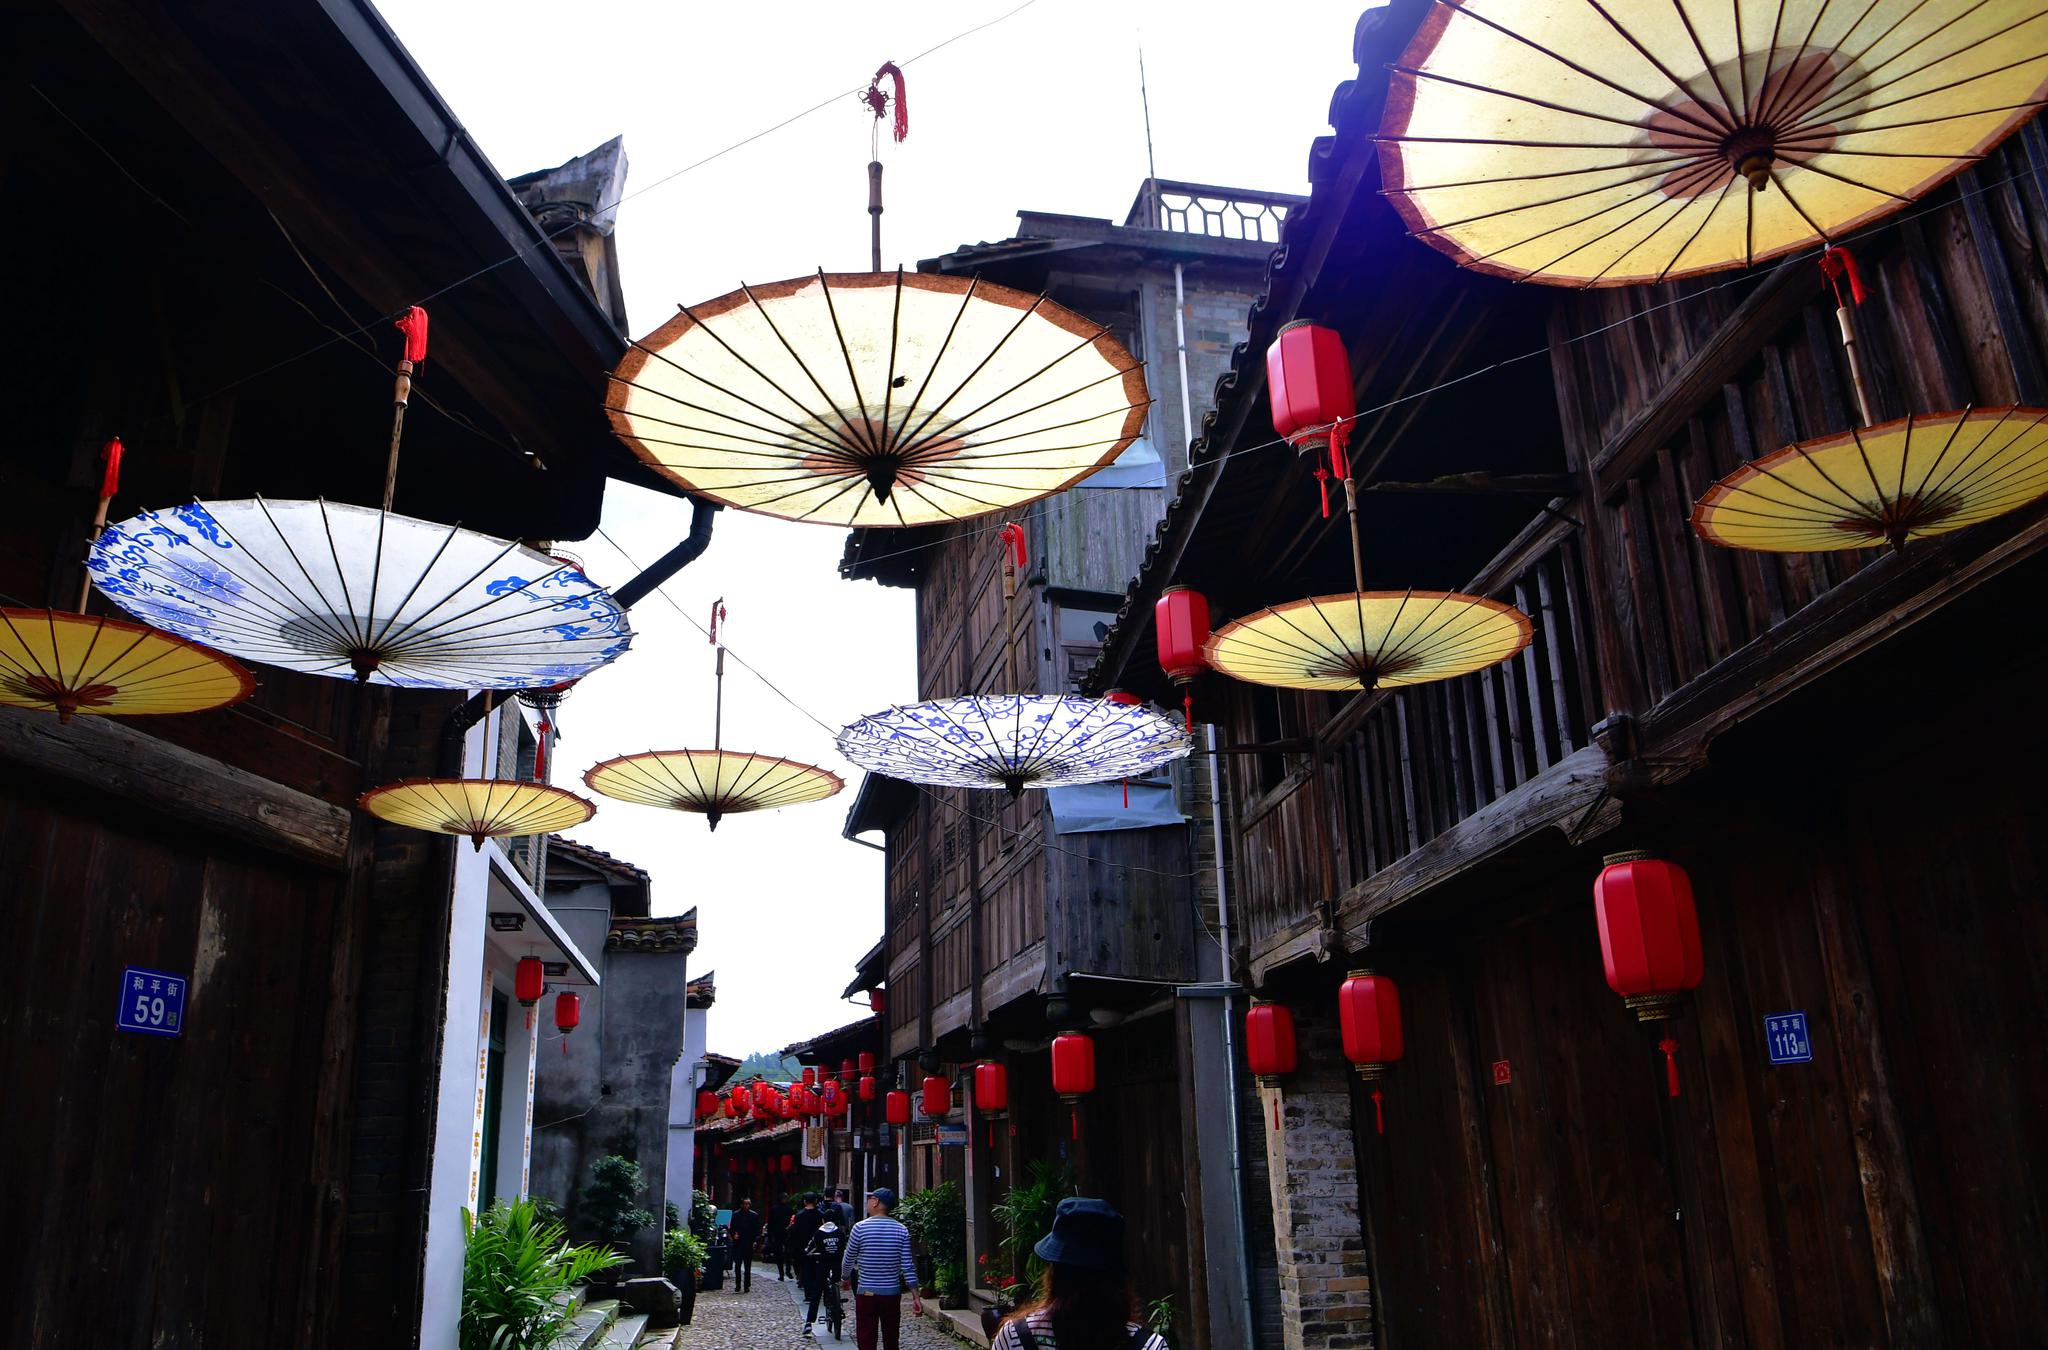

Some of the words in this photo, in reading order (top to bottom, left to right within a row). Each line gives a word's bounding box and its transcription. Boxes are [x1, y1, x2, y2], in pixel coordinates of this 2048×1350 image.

[133, 976, 178, 997] 和平街
[134, 995, 165, 1025] 59
[1775, 1033, 1798, 1056] 113
